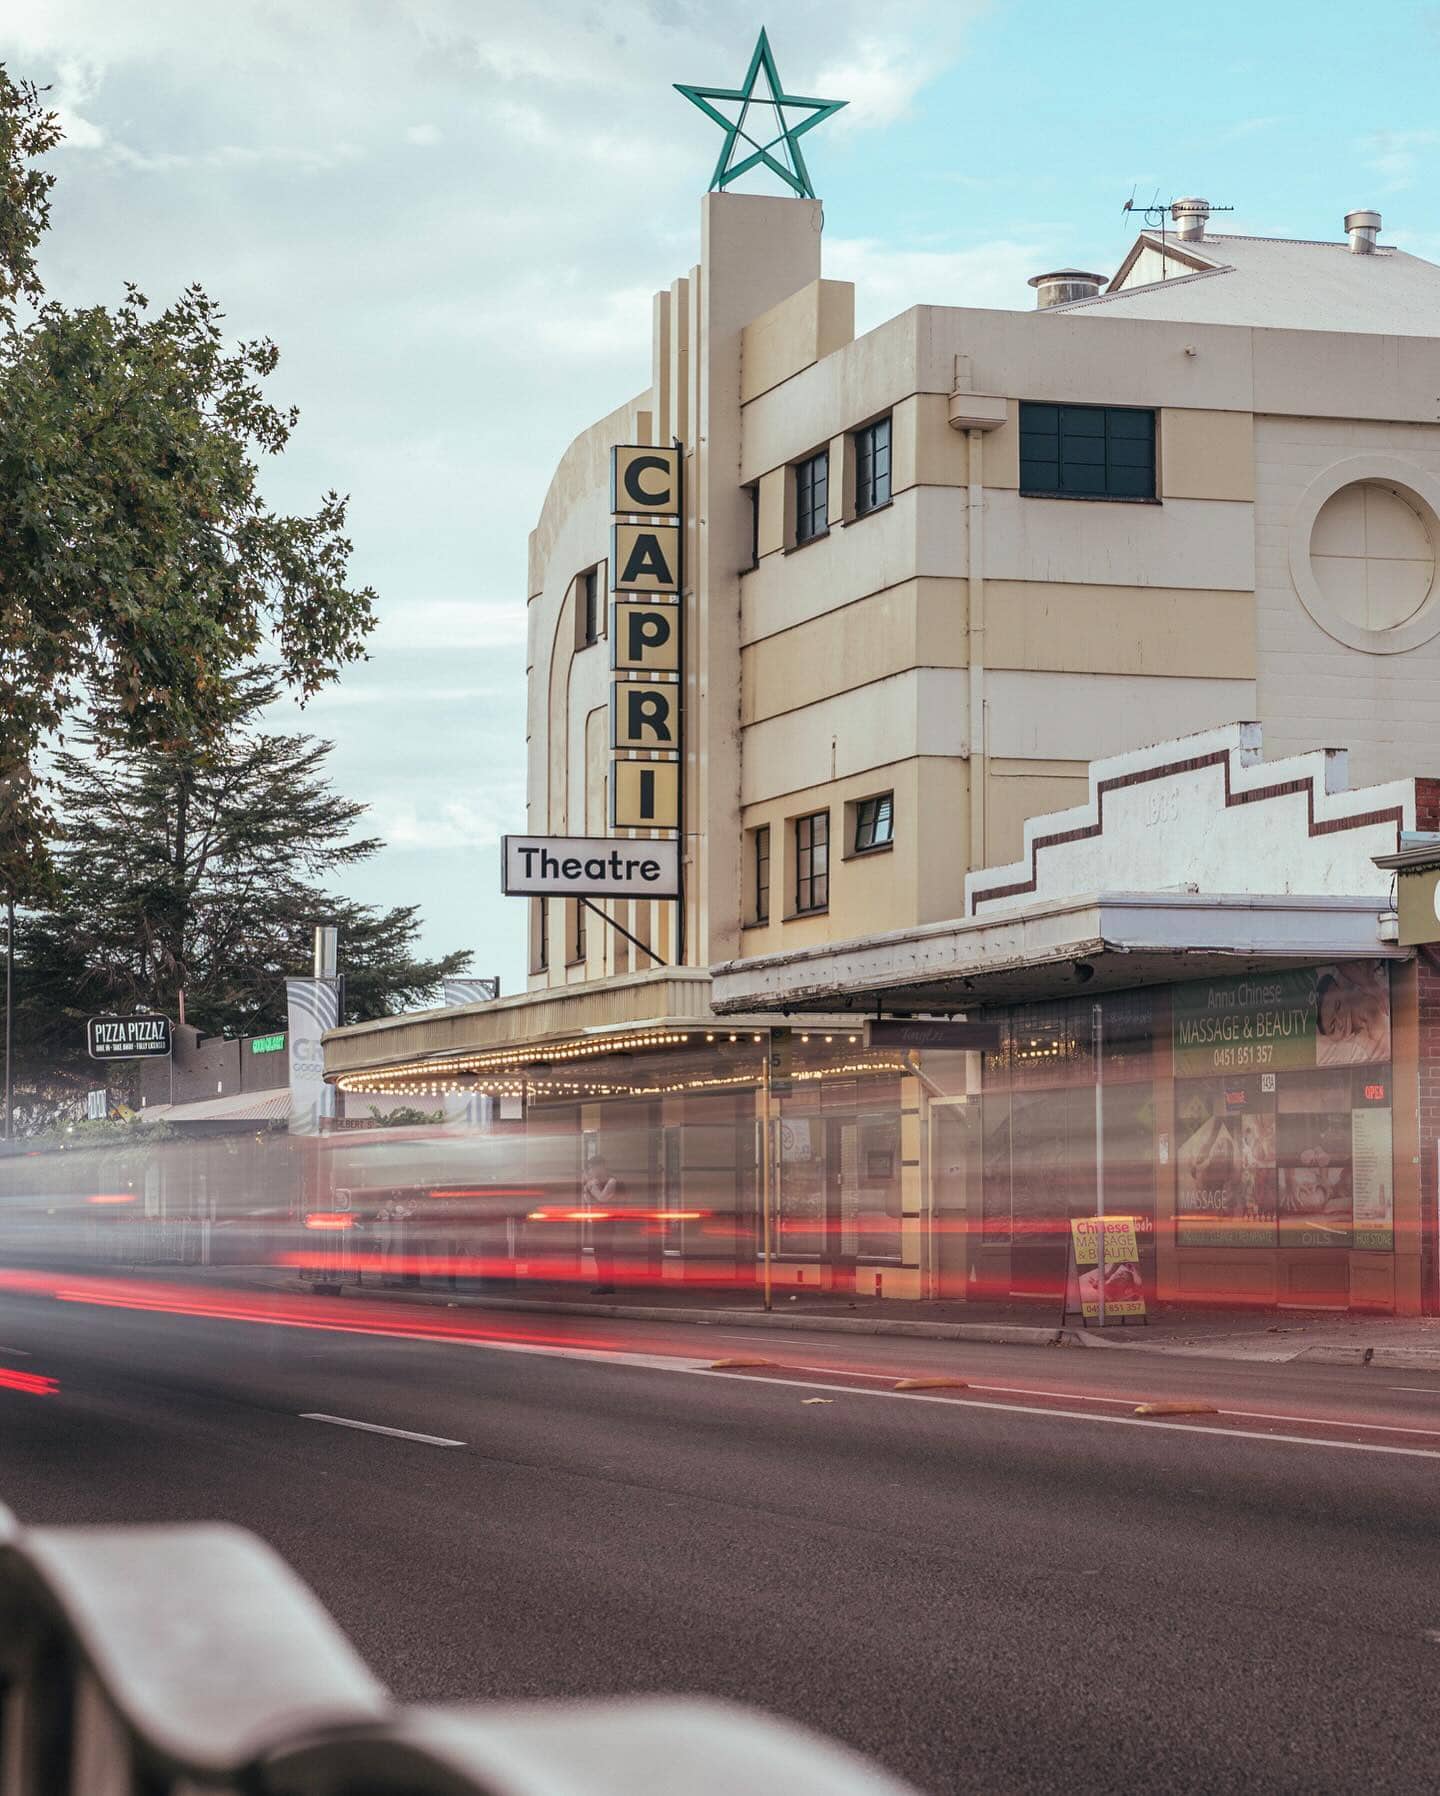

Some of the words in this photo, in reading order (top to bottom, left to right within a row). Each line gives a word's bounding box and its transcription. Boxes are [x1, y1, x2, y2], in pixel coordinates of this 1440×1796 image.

[620, 455, 673, 820] CAPRI
[518, 848, 660, 881] Theatre
[1238, 983, 1282, 1006] Chinese
[95, 1023, 126, 1042] PIZZA
[128, 1021, 165, 1041] PIZZAZ
[1179, 1015, 1239, 1044] MASSAGE
[1242, 1015, 1253, 1039] &
[1257, 1009, 1309, 1037] BEAUTY
[1213, 1048, 1234, 1066] 0451
[1237, 1046, 1254, 1064] 851
[1256, 1045, 1273, 1063] 357
[1365, 1086, 1384, 1099] OPEN
[1181, 1190, 1227, 1209] MASSAGE
[1077, 1222, 1130, 1234] Chiese
[1076, 1235, 1133, 1247] MASAGE
[1089, 1247, 1134, 1259] BAUTY
